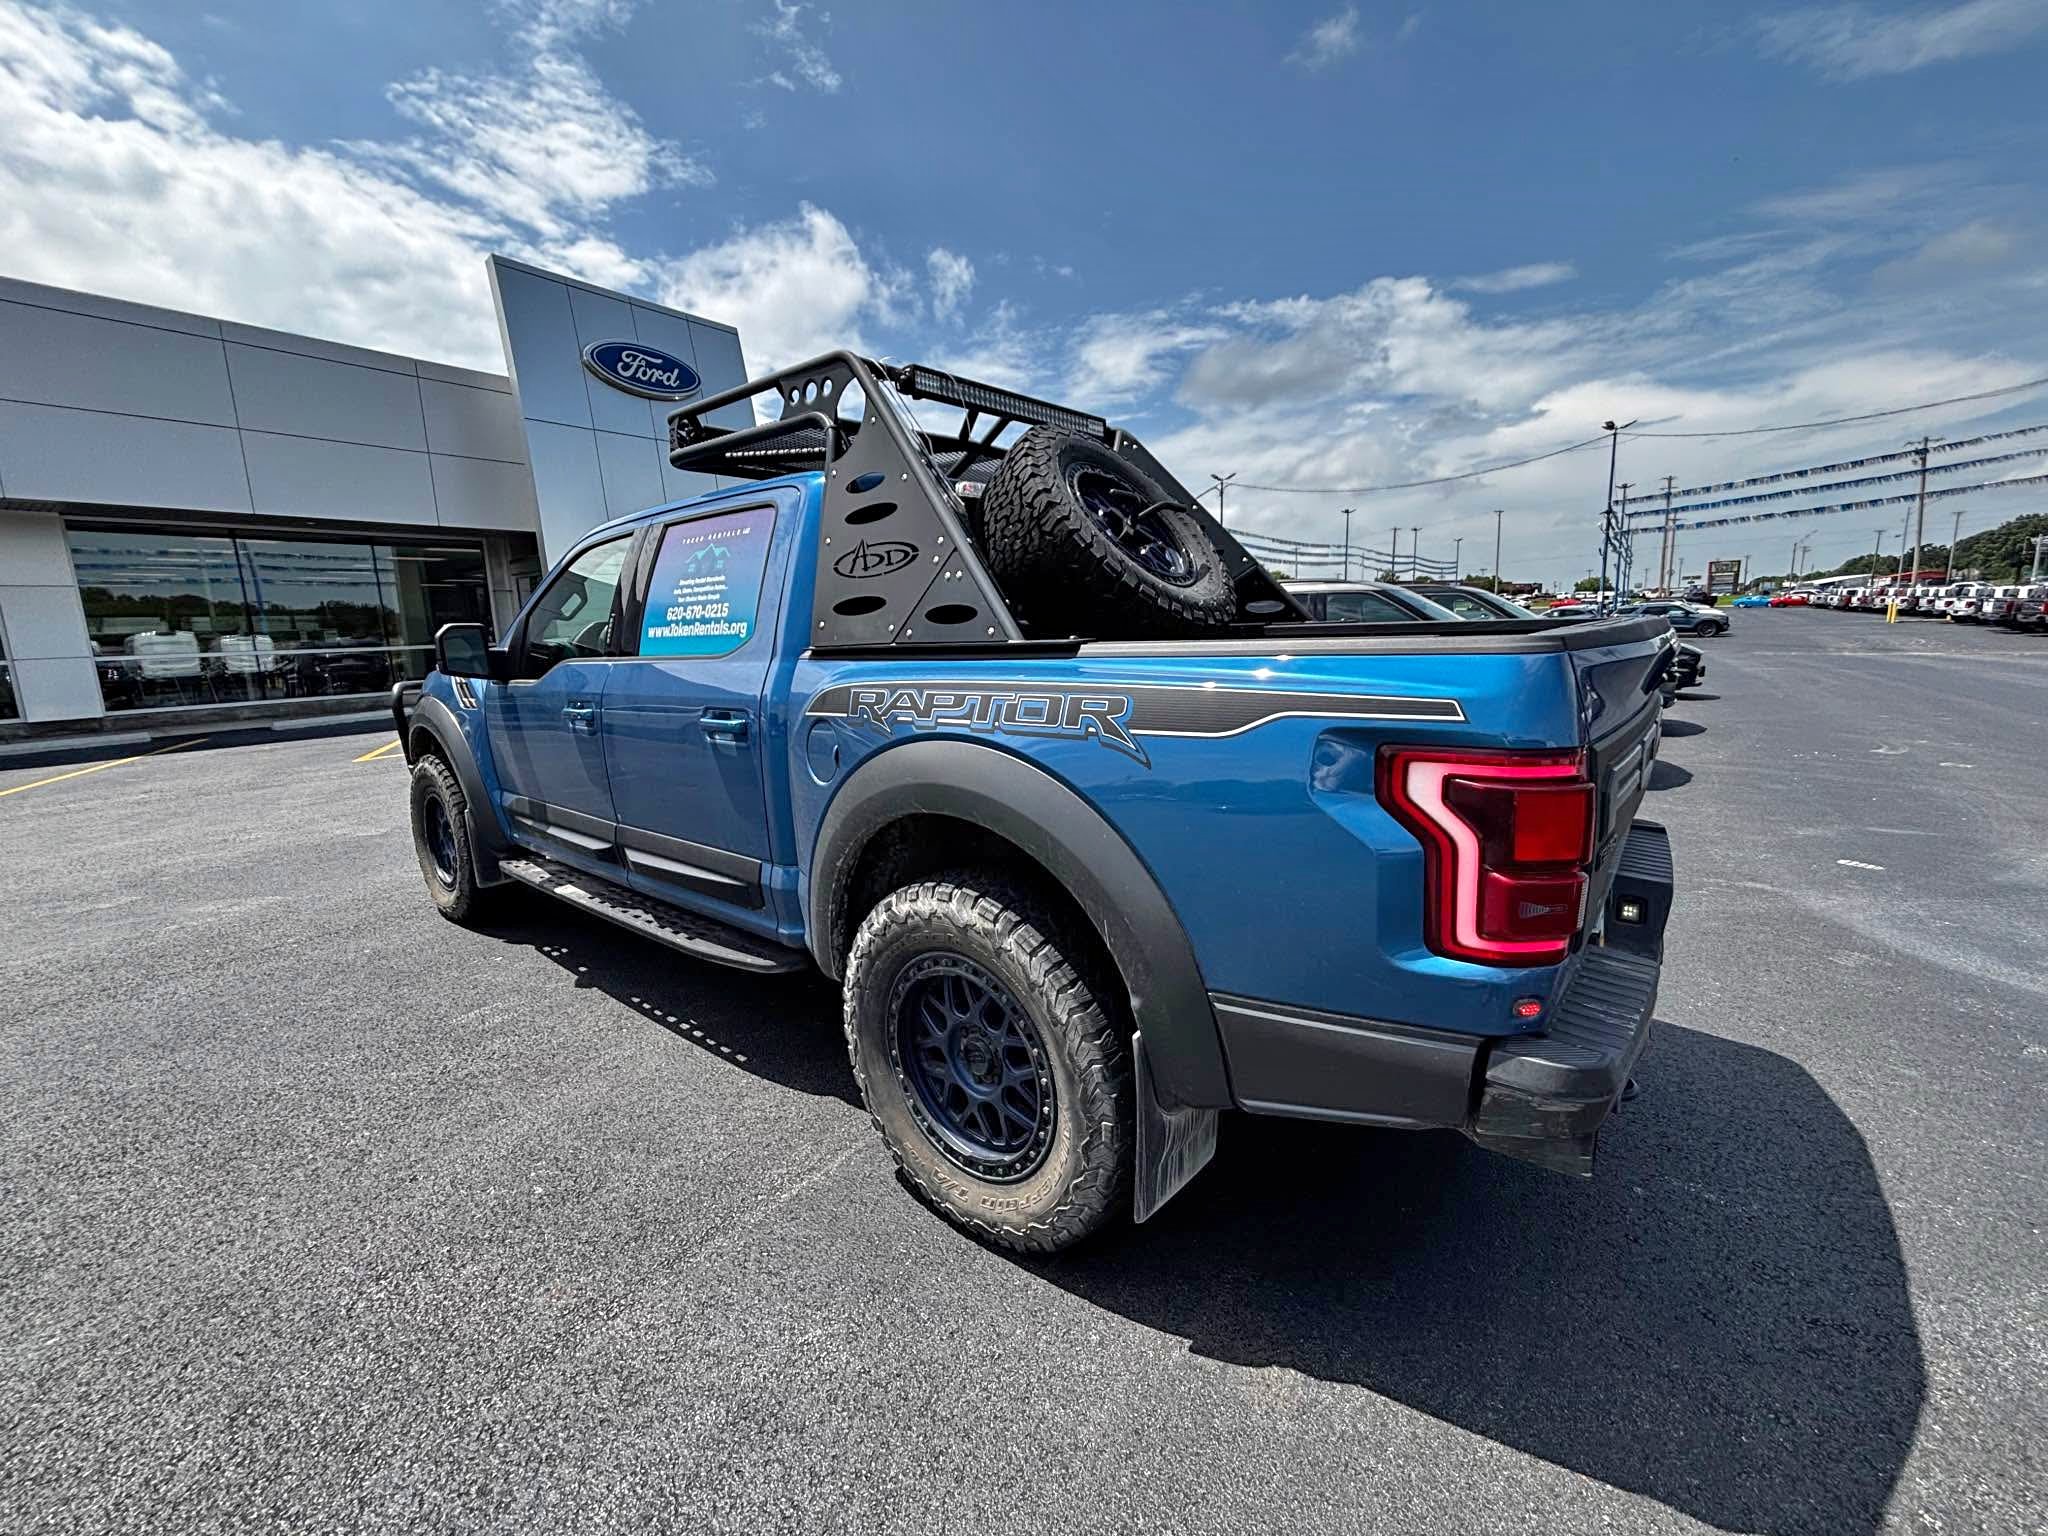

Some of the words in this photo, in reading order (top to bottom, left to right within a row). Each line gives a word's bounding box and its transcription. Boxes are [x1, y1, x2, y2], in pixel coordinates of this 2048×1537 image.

[617, 350, 679, 387] Ford
[667, 604, 729, 620] 620-670-0215
[647, 620, 748, 638] www.TokenRentals.org
[848, 687, 1144, 762] RAPTOR
